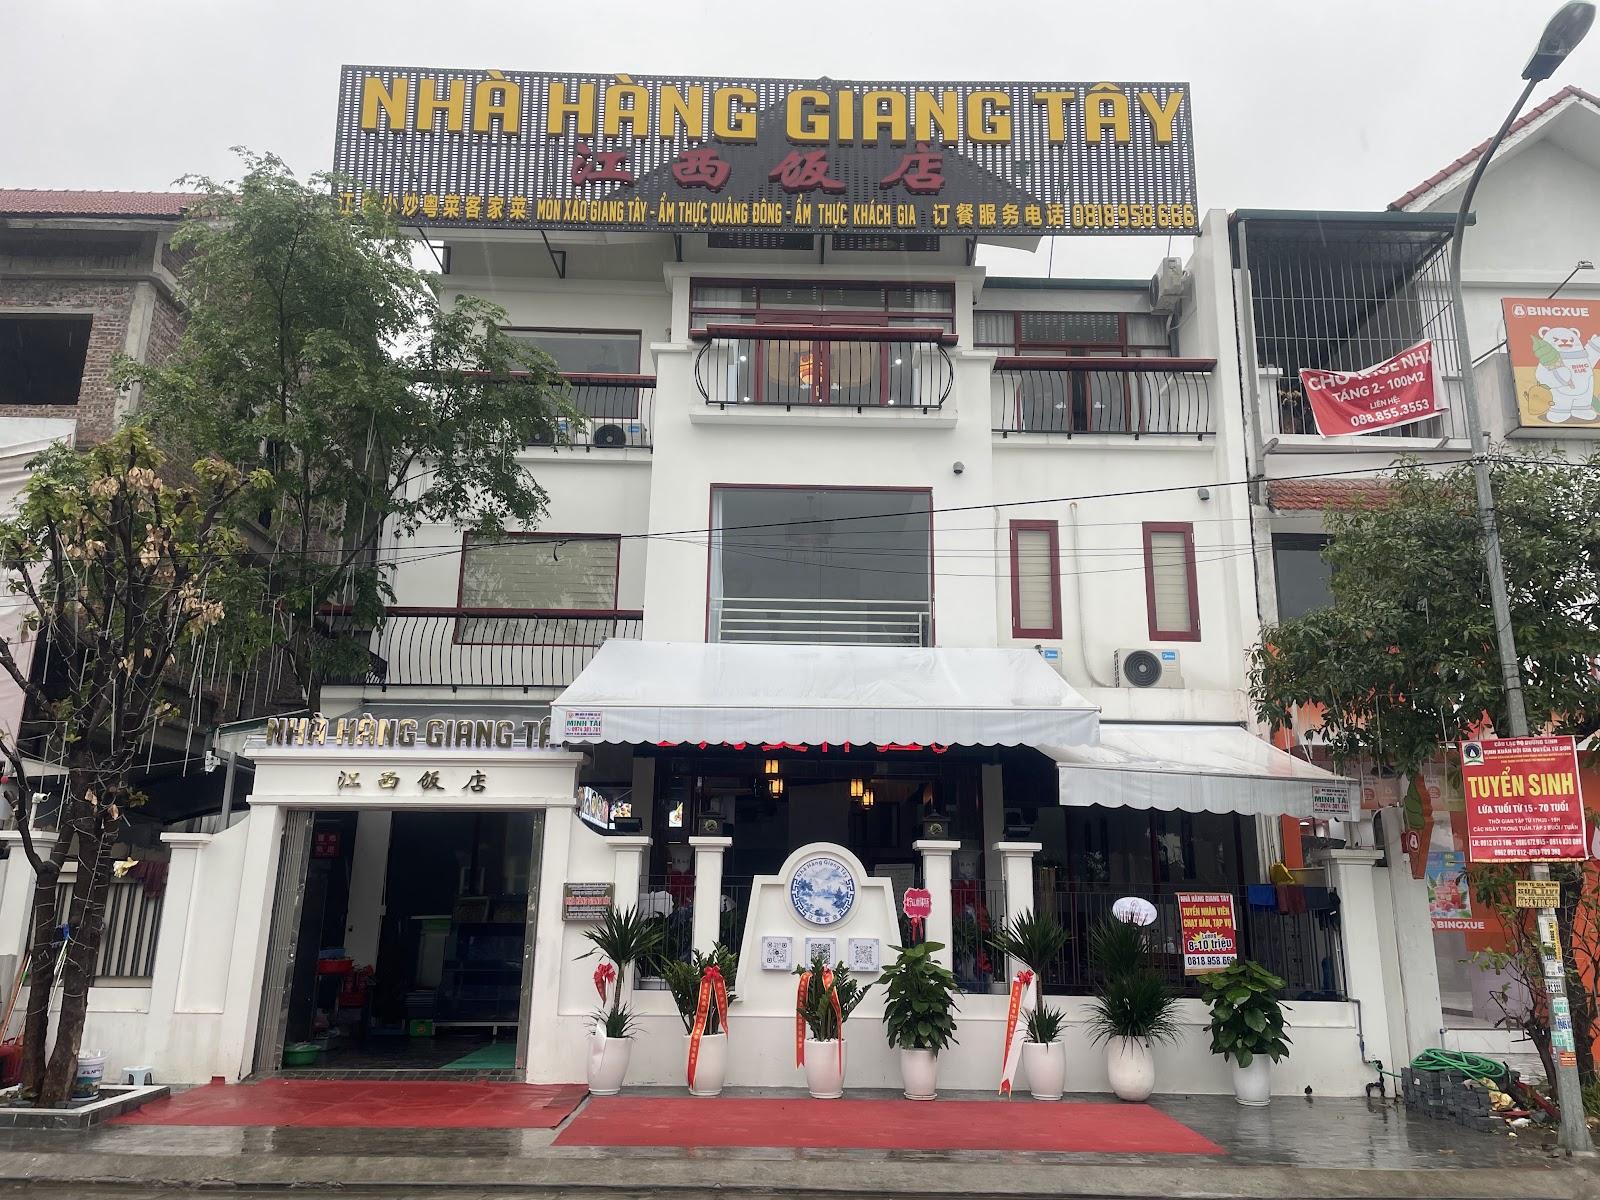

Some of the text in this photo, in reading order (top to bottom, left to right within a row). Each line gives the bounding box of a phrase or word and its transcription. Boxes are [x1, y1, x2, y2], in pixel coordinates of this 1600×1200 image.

[361, 69, 1184, 147] NHÀ HÀNG GIANG TÂY
[571, 143, 946, 196] 江西饭店
[536, 194, 561, 221] MÓN
[563, 195, 587, 222] XÀO
[590, 199, 624, 223] GIANG
[627, 197, 648, 223] TÂY
[658, 192, 675, 223] ẨM
[678, 200, 708, 229] THỰC
[710, 197, 749, 224] QUẢNG
[752, 198, 782, 224] ĐÔNG
[794, 194, 811, 225] ẨM
[818, 202, 847, 229] THỰC
[853, 199, 891, 226] KHÁCH
[897, 204, 916, 226] GIA
[932, 203, 1064, 228] 订餐服务电话
[1527, 306, 1589, 317] BINGXUE
[1387, 371, 1426, 391] 100M2
[1351, 399, 1430, 427] 088.855.3553
[266, 711, 330, 747] NHÀ
[336, 712, 418, 747] HÀNG
[425, 719, 516, 749] GIANG
[337, 769, 488, 793] 江西饭店
[1468, 766, 1525, 798] TUYỂN
[1528, 772, 1574, 796] SINH
[1314, 796, 1335, 804] MINH
[1478, 800, 1569, 814] LỨA TUỔI TỪ 15 70 TUỔI
[823, 860, 841, 870] Giang
[1436, 920, 1485, 930] BINGXUE
[1188, 940, 1209, 951] 8-10
